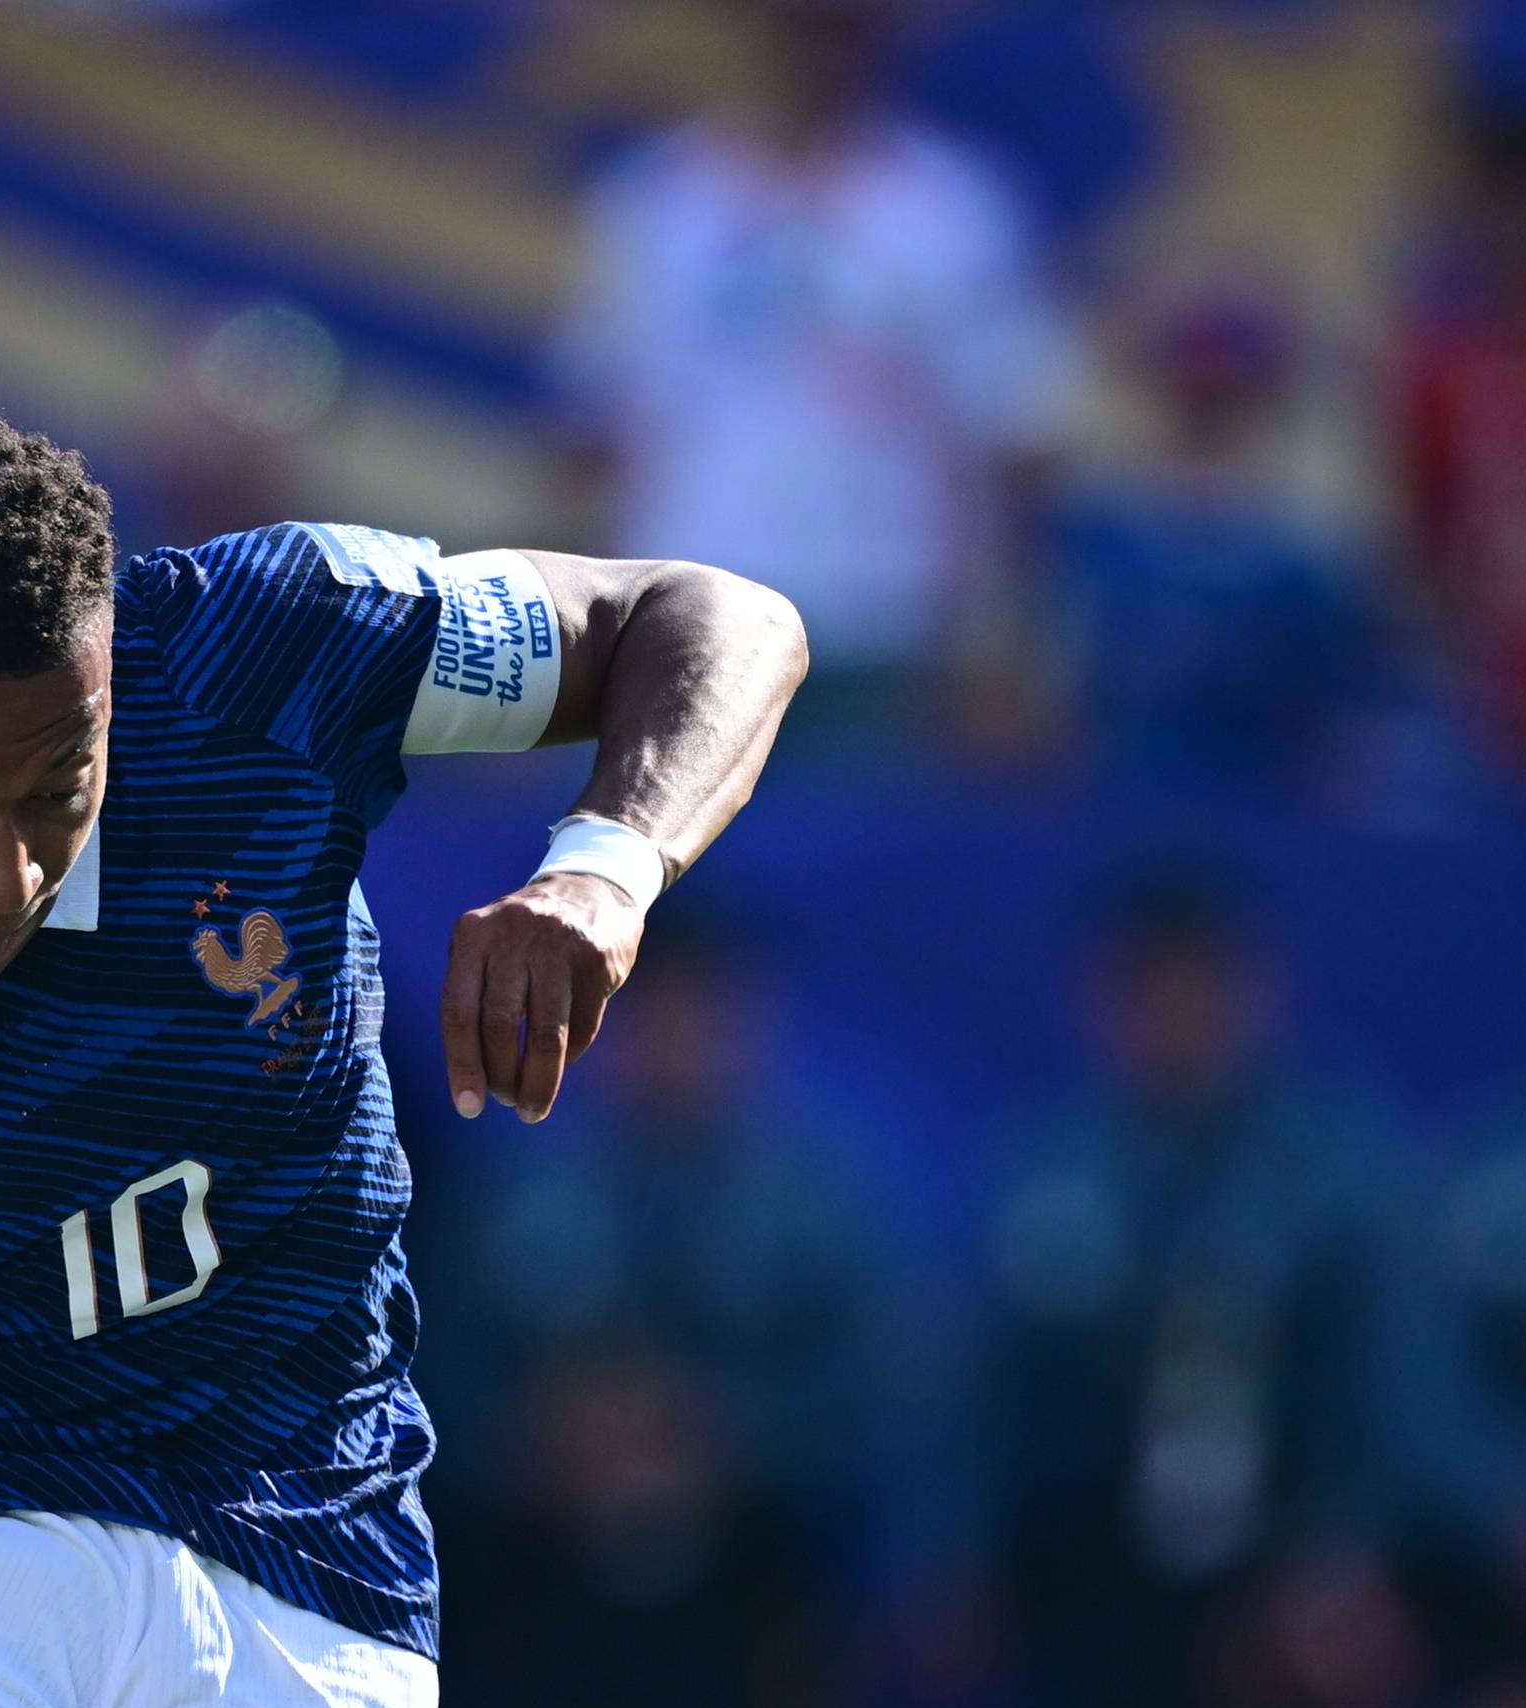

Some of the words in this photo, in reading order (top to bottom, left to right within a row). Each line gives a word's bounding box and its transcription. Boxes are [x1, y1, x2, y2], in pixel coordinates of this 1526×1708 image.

[433, 573, 460, 690] FOOTBALL
[455, 577, 495, 697] UNITES
[479, 575, 525, 647] World
[528, 602, 550, 655] FIFA
[496, 652, 524, 707] the
[59, 1159, 224, 1341] 10
